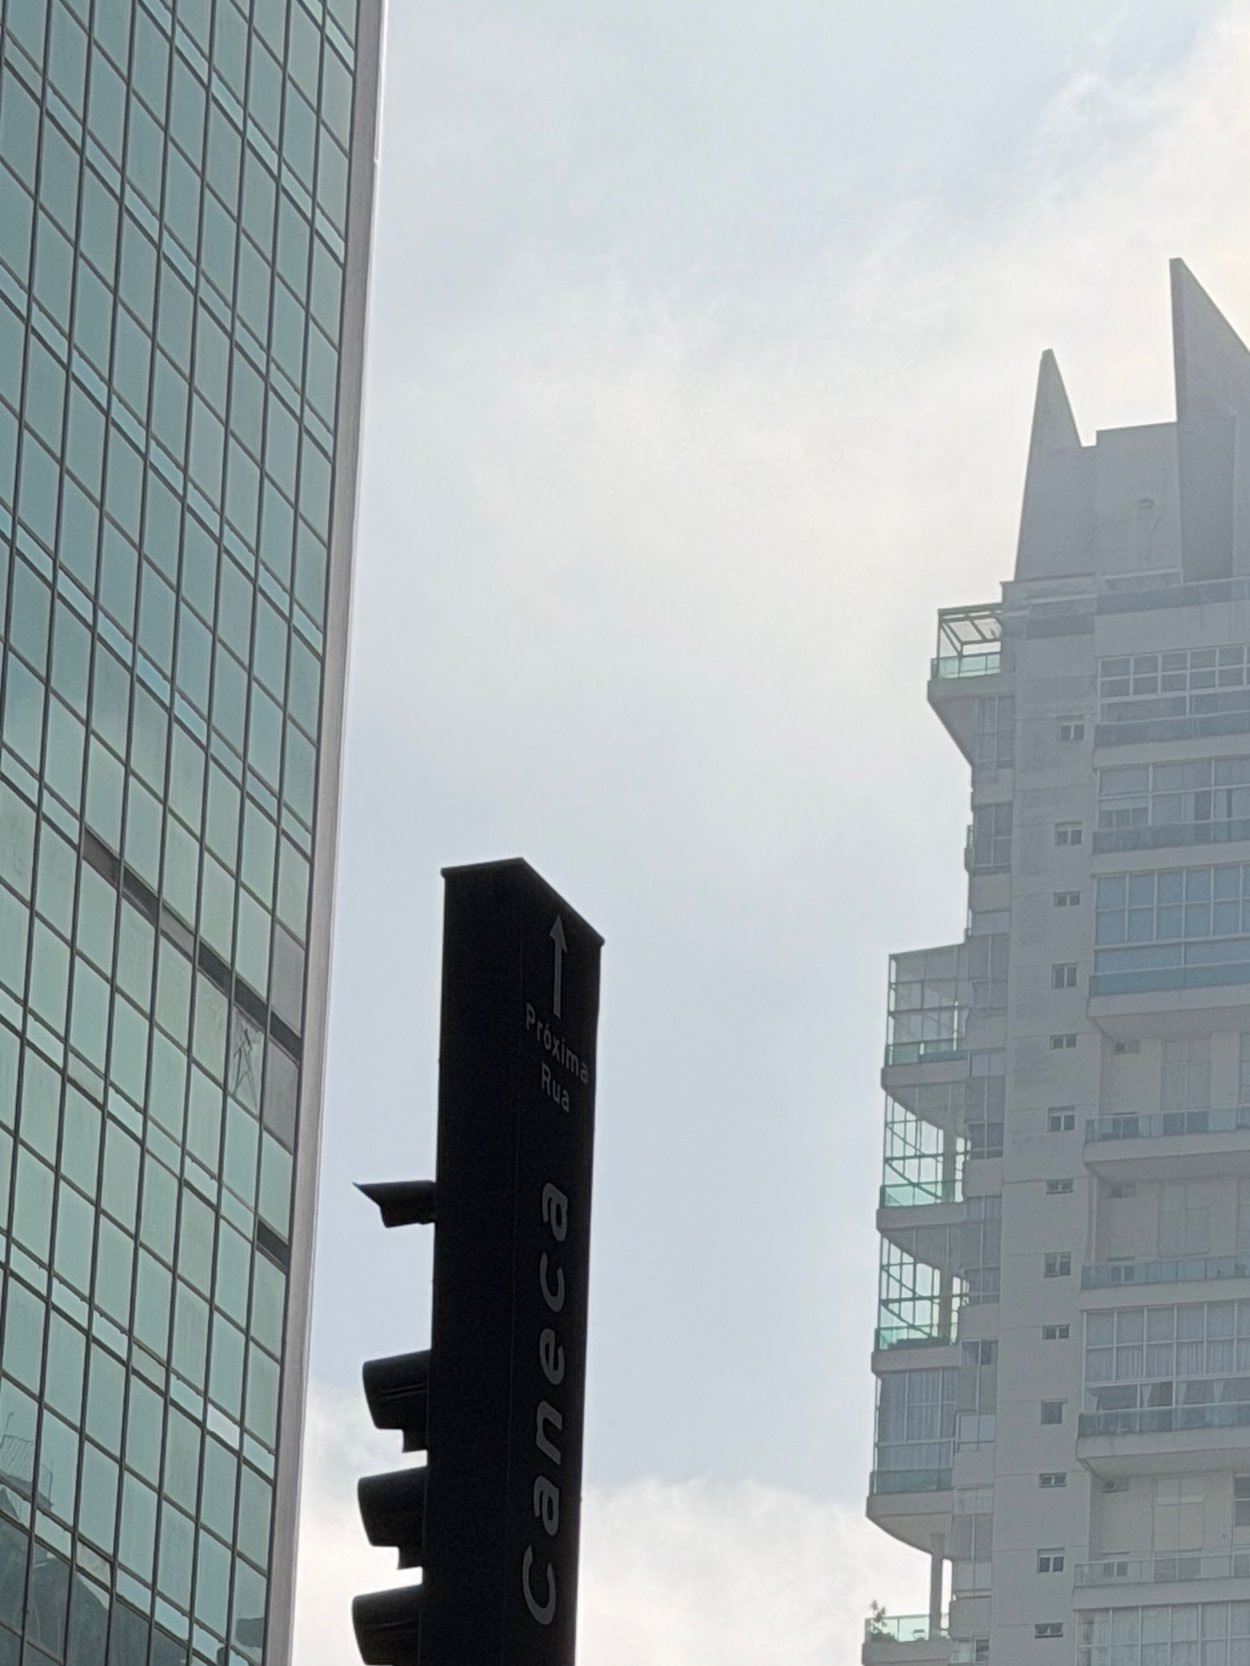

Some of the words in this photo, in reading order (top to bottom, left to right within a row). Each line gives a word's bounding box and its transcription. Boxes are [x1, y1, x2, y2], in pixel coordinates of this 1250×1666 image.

[525, 1002, 589, 1084] Próxima
[540, 1061, 571, 1114] Rua
[521, 1181, 569, 1626] Caneca
